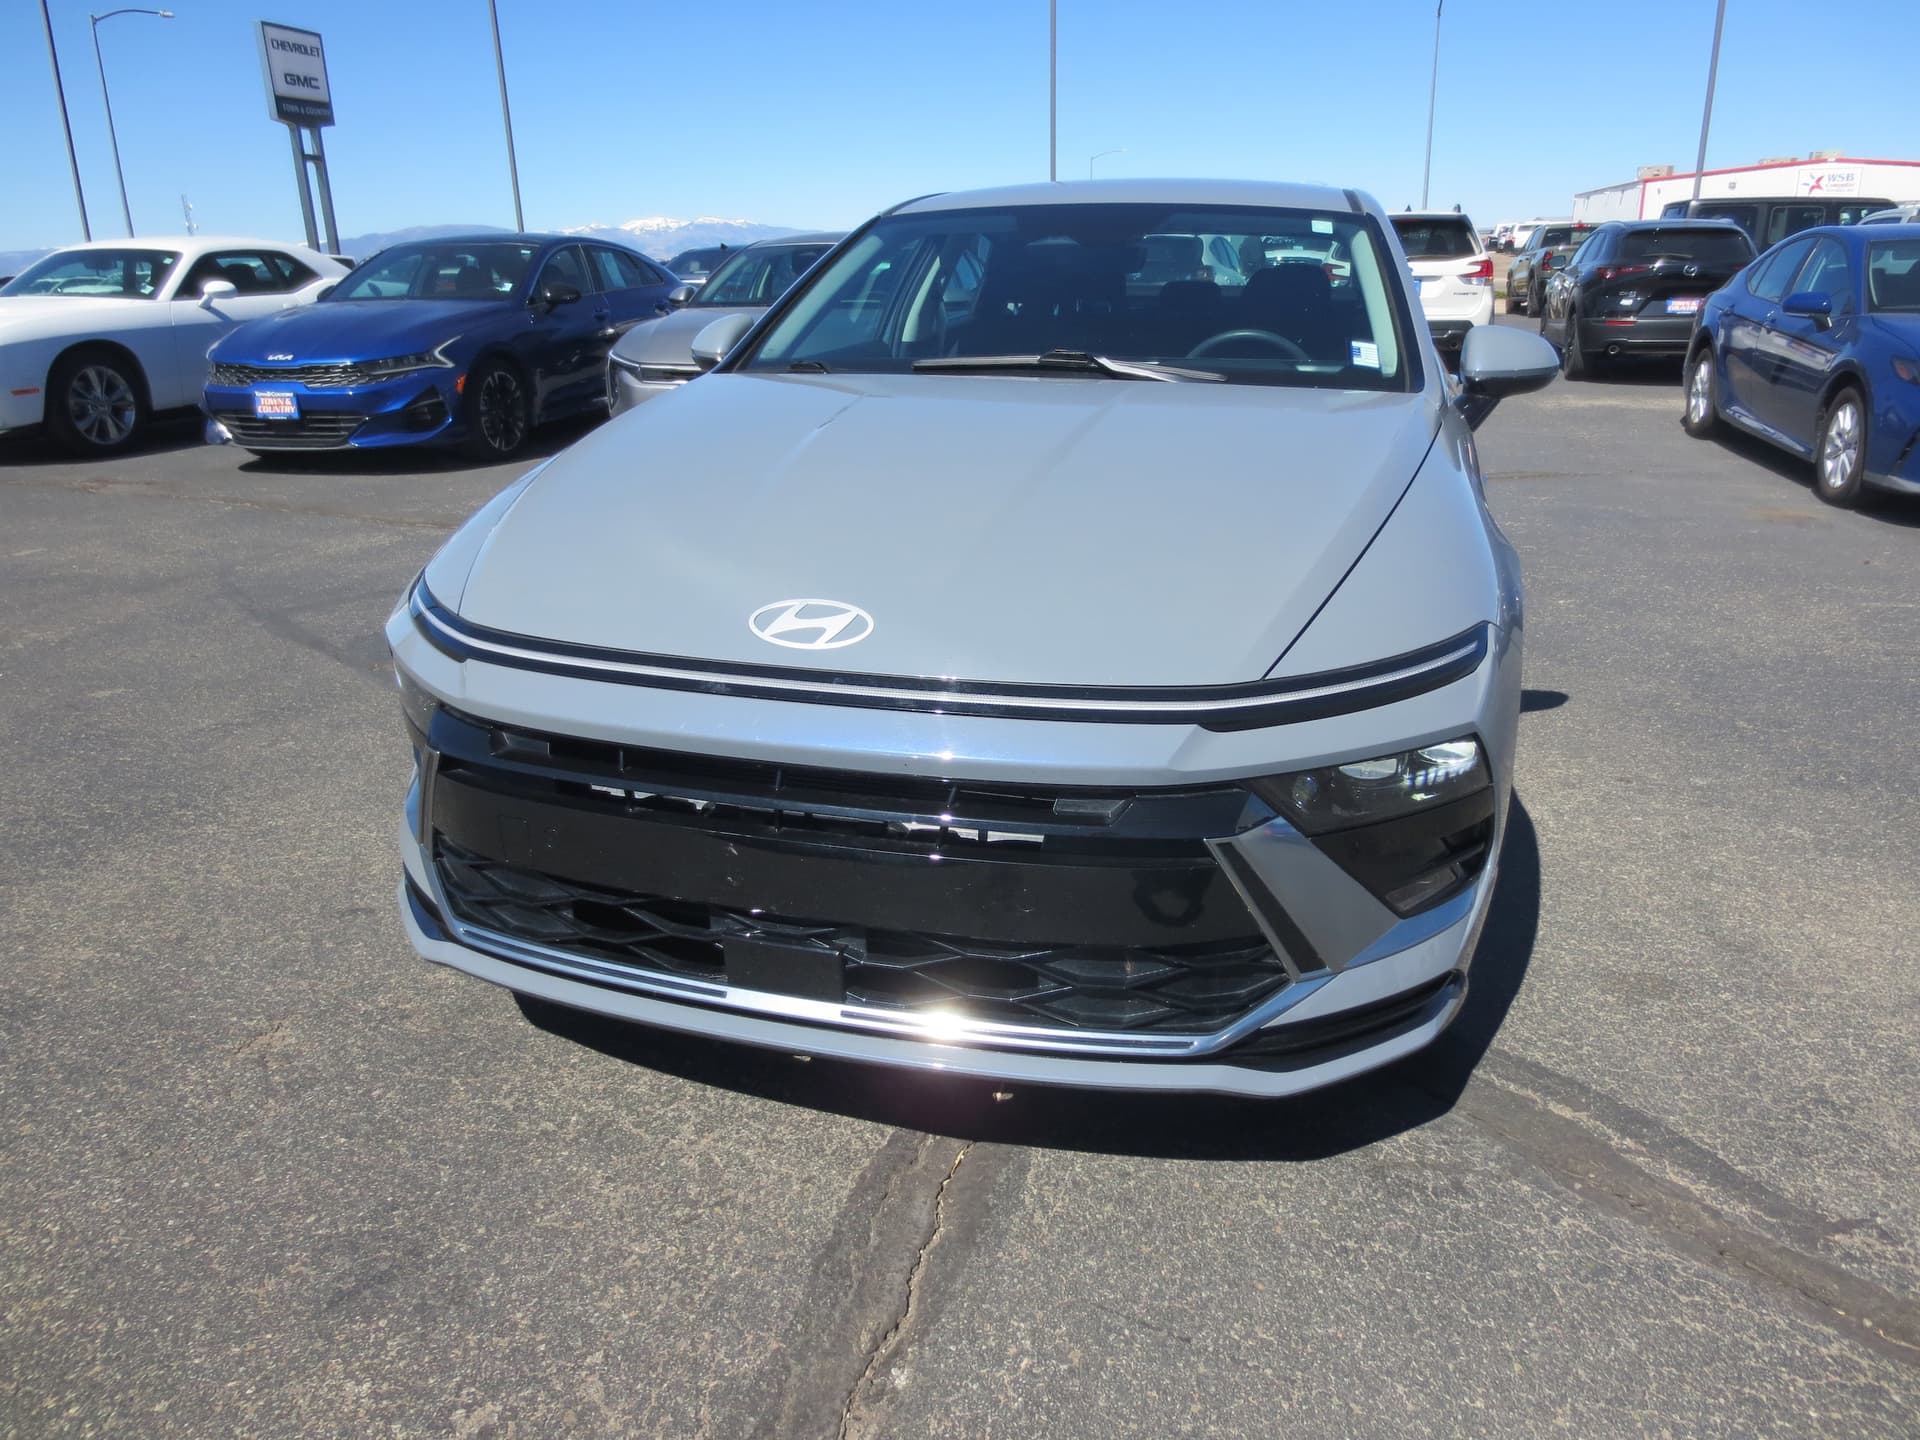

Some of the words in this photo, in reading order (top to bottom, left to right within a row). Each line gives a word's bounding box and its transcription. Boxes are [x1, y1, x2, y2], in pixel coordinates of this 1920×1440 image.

[270, 38, 320, 58] CHEVROLET
[284, 73, 320, 90] GMC
[1827, 173, 1855, 182] WSB
[260, 397, 283, 405] TOWN
[285, 397, 292, 405] &
[258, 405, 296, 414] COUNTRY
